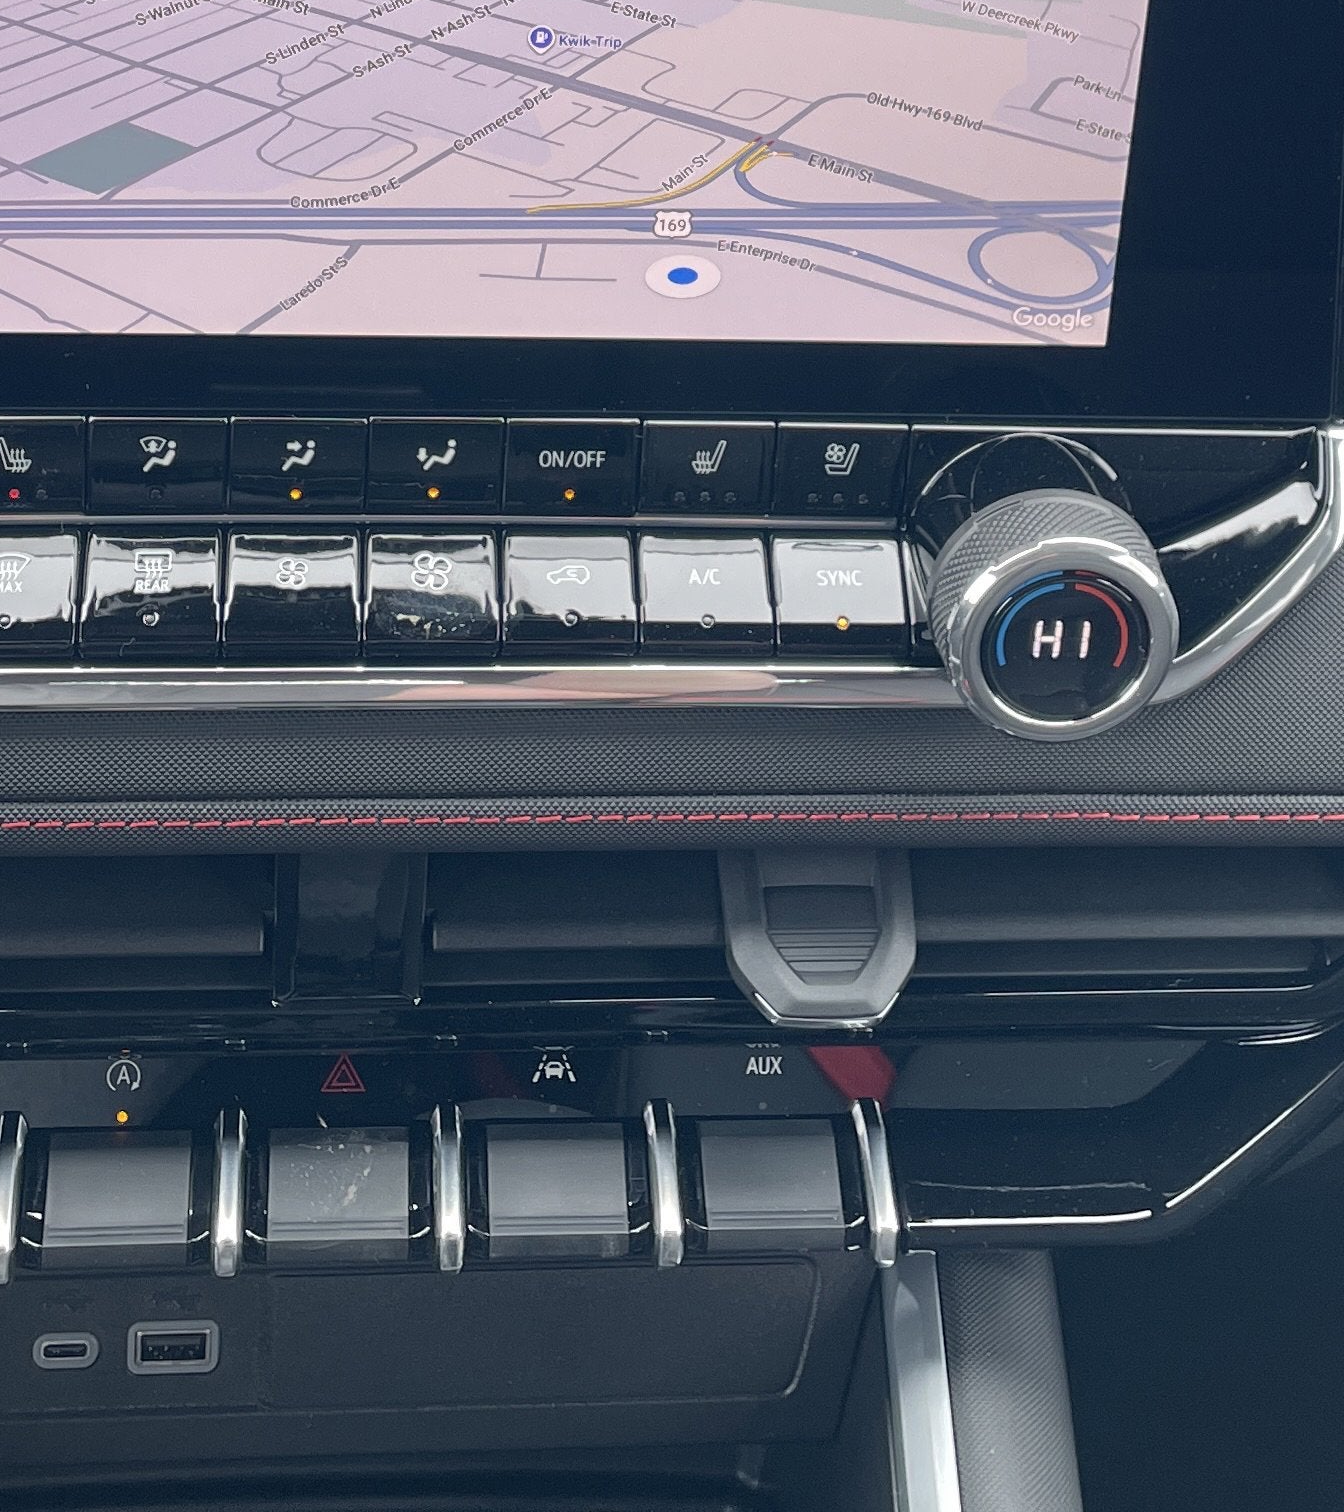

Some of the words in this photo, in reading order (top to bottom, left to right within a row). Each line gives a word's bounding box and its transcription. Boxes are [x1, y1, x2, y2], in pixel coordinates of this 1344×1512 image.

[962, 0, 976, 13] W
[978, 3, 1042, 33] Deercreek
[1044, 21, 1080, 43] Pkwy
[559, 35, 590, 47] Kwik
[595, 36, 622, 49] Trip
[1074, 75, 1102, 95] Park
[1103, 88, 1122, 102] Ln
[453, 106, 523, 152] Commerce
[523, 96, 540, 112] Dr
[540, 88, 552, 101] E
[866, 92, 889, 107] Old
[893, 98, 923, 121] Hwy
[927, 107, 950, 121] 169
[953, 114, 983, 132] Blvd
[662, 165, 690, 192] Main
[690, 154, 708, 170] St
[808, 154, 819, 167] E
[821, 157, 855, 179] Main
[857, 169, 873, 183] St
[290, 189, 369, 209] Commerce
[371, 182, 390, 198] Dr
[390, 176, 400, 190] E
[659, 219, 686, 232] 169
[718, 240, 726, 252] E
[730, 241, 798, 268] Enterprise
[798, 258, 816, 272] Dr
[280, 276, 323, 311] Laredo
[321, 265, 338, 282] St
[336, 256, 348, 269] S
[1013, 306, 1093, 331] Google
[539, 451, 606, 469] ON/OFF
[135, 579, 169, 593] REAR
[689, 568, 721, 586] A/C
[817, 569, 863, 587] SYNC
[746, 1056, 782, 1075] AUX
